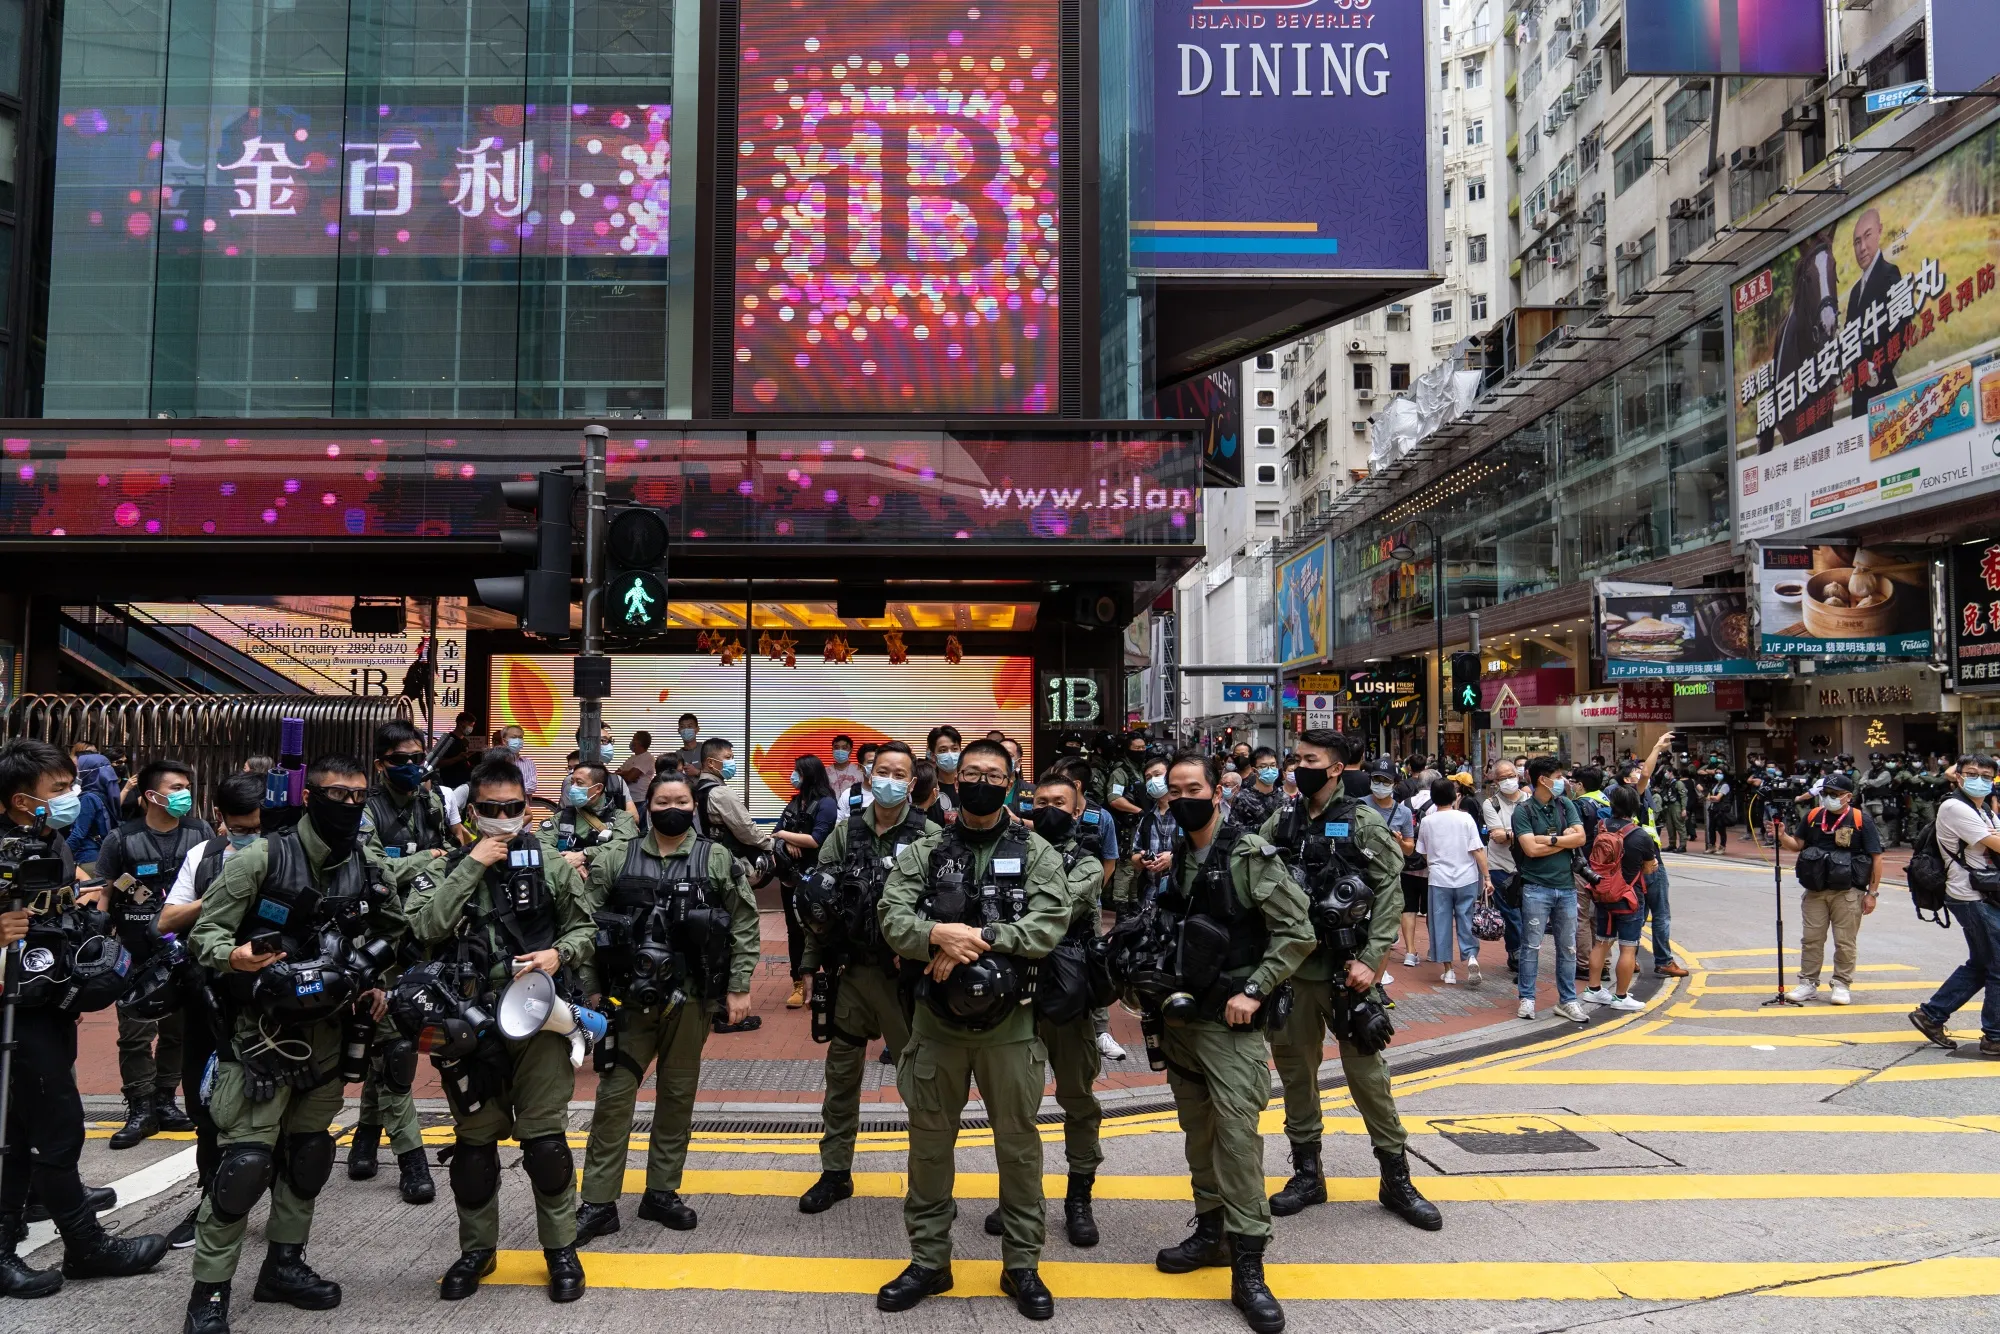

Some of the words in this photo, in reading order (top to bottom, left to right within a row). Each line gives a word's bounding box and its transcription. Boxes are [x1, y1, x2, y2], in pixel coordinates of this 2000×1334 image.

[1189, 13, 1266, 29] ISLAND
[1276, 13, 1376, 29] BEVERLEY
[1177, 42, 1391, 97] DINING
[216, 136, 535, 218] 金百利
[1757, 258, 1945, 433] 馬百良安宮牛黃丸
[1741, 359, 1775, 405] 我信!
[1942, 467, 1968, 484] STYLE
[247, 624, 314, 640] Fashion
[245, 643, 289, 658] Leasing
[294, 643, 337, 658] Enquiry
[347, 643, 377, 655] 2890
[379, 643, 408, 655] 6870
[1766, 642, 1781, 653] 1/F
[1783, 643, 1795, 652] JP
[1797, 641, 1822, 652] Plaza
[1825, 641, 1886, 654] 翡翠明珠廣場
[441, 639, 460, 707] 金百利
[1611, 667, 1626, 675] 1/F
[1627, 666, 1638, 675] JP
[1640, 665, 1663, 675] Plaza
[1666, 663, 1724, 675] 翡翠明珠廣場
[1355, 682, 1395, 694] LUSH
[1673, 682, 1707, 696] Pricerite
[1819, 690, 1846, 706] MR.
[1848, 686, 1877, 703] TEA
[1048, 677, 1101, 722] iB
[1583, 706, 1599, 717] ETUDE
[1599, 706, 1618, 716] HOUSE
[130, 914, 150, 922] POLICE
[297, 981, 323, 995] 3-HQ
